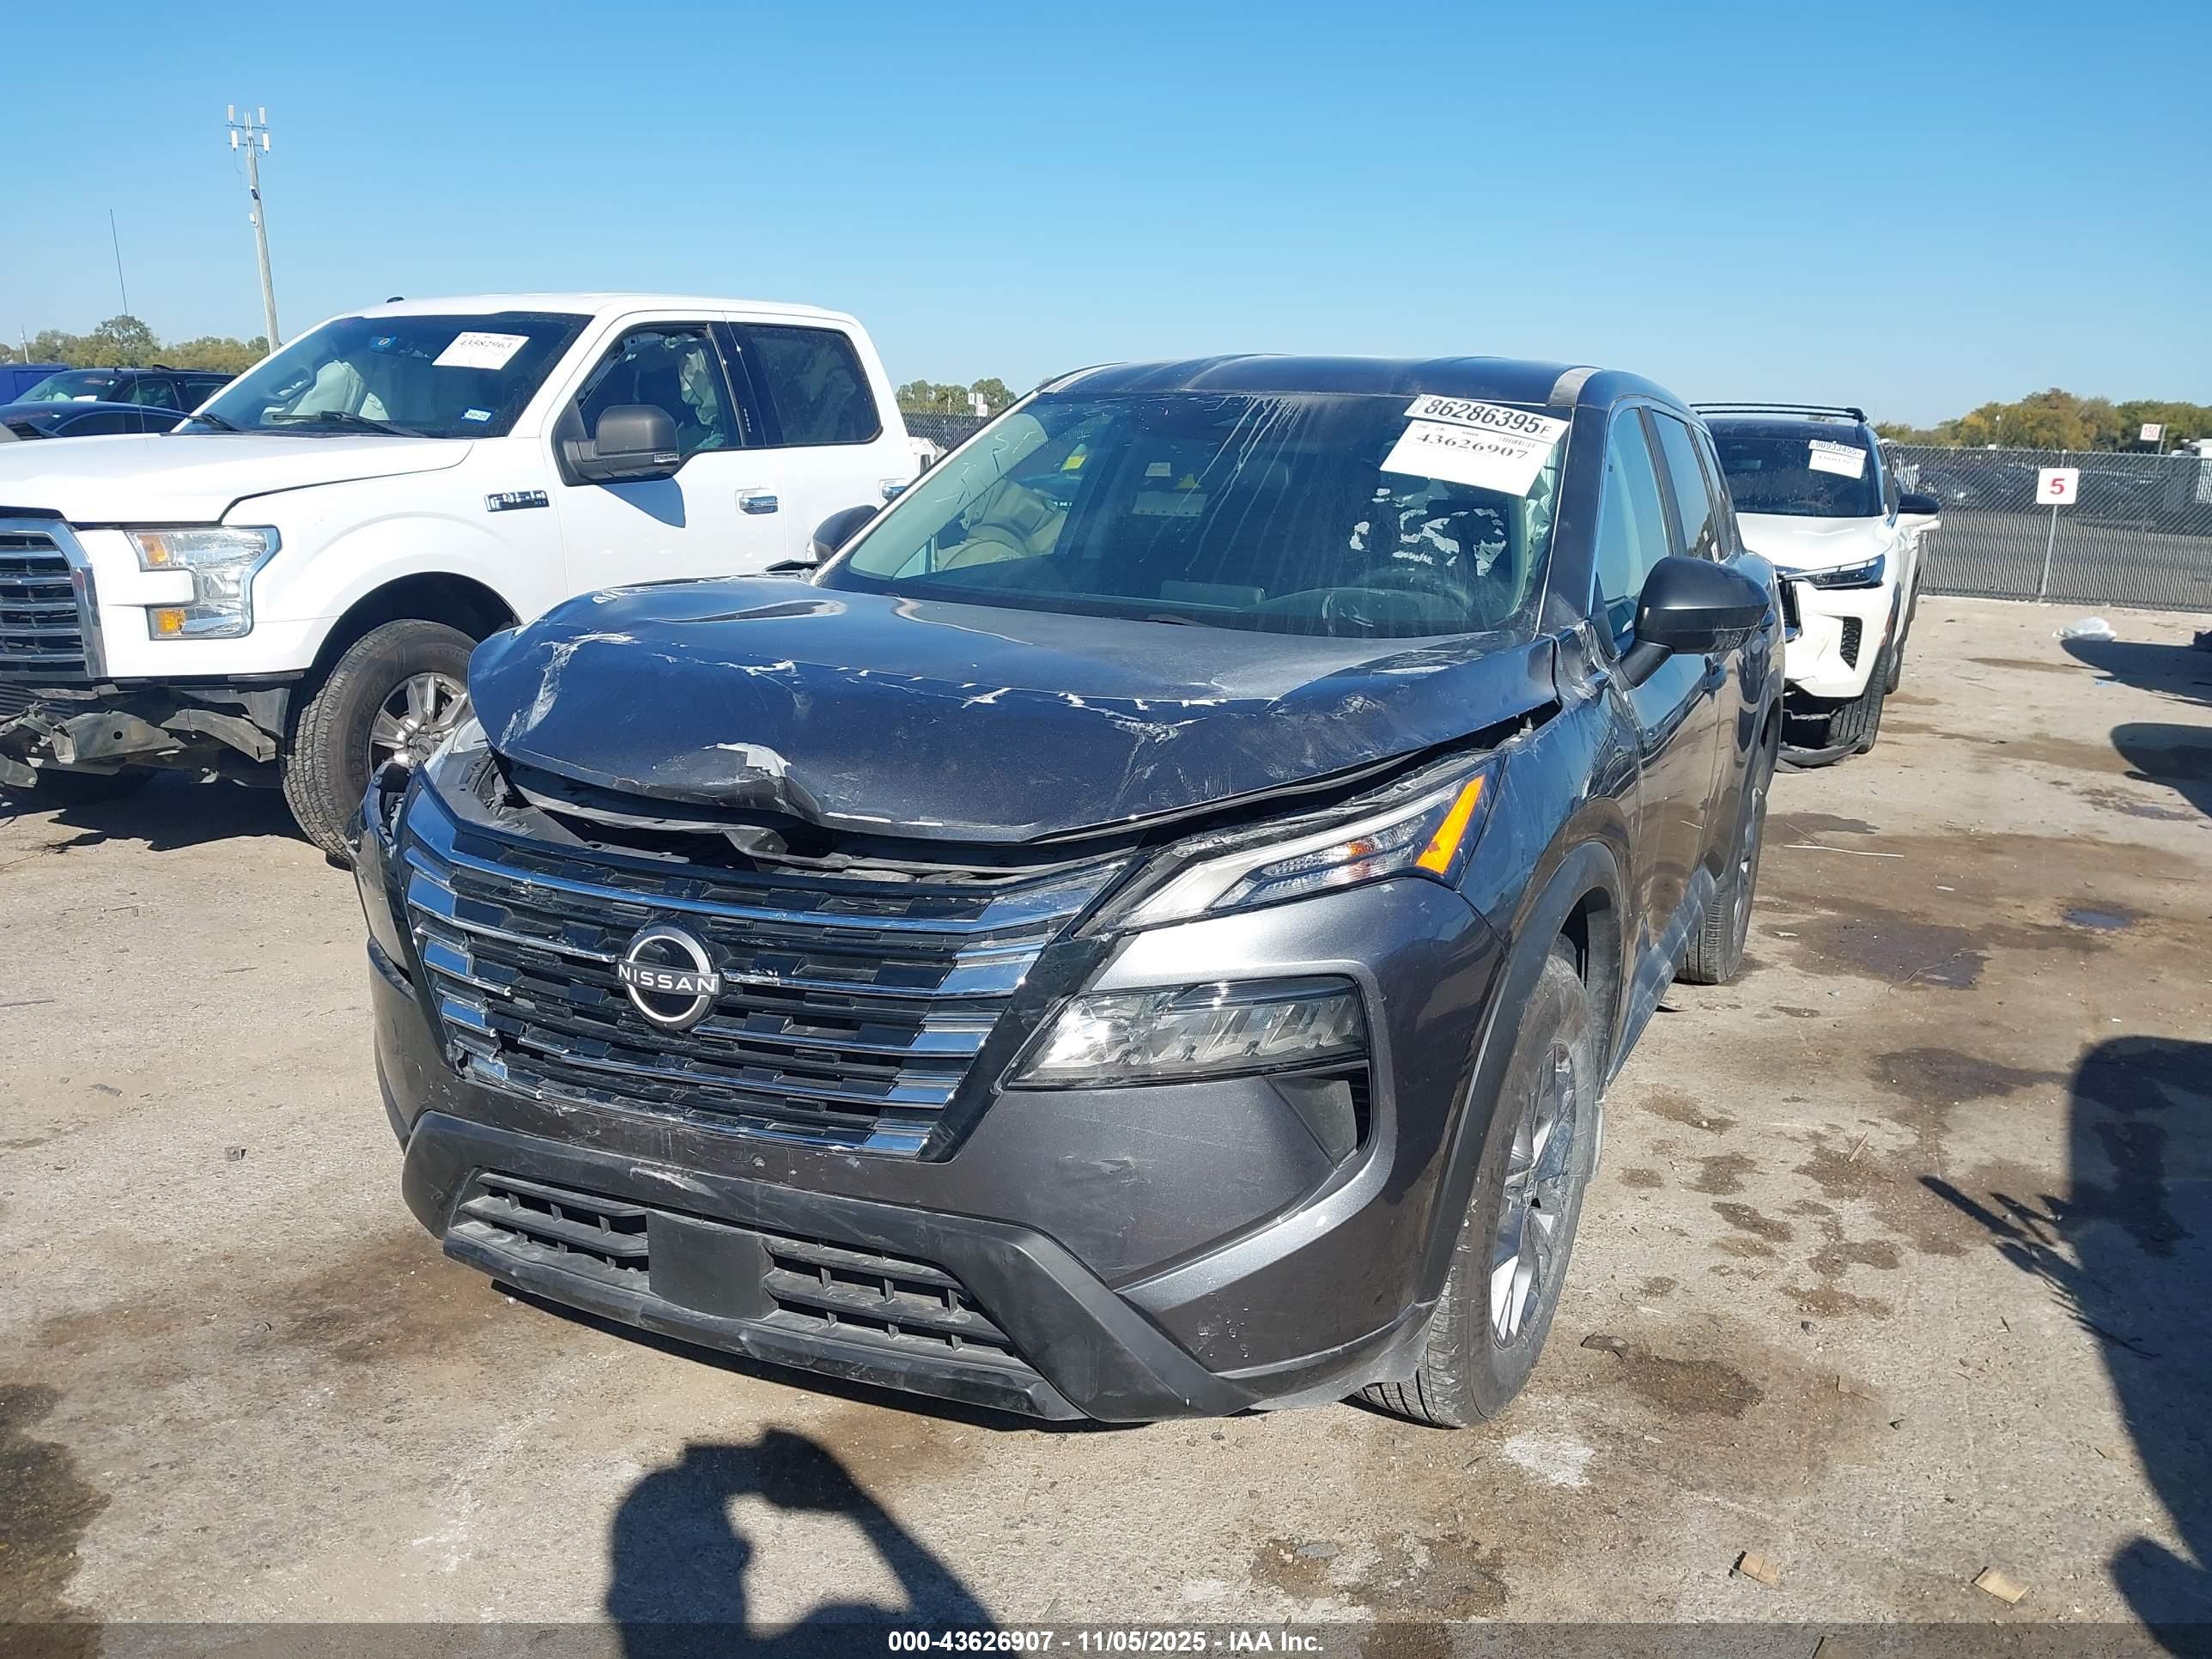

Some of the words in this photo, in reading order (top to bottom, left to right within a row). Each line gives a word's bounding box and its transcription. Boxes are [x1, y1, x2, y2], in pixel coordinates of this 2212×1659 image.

[1424, 398, 1544, 434] 86286395
[1414, 433, 1530, 460] 43626907
[2049, 477, 2065, 495] 5
[618, 963, 715, 993] NISSAN
